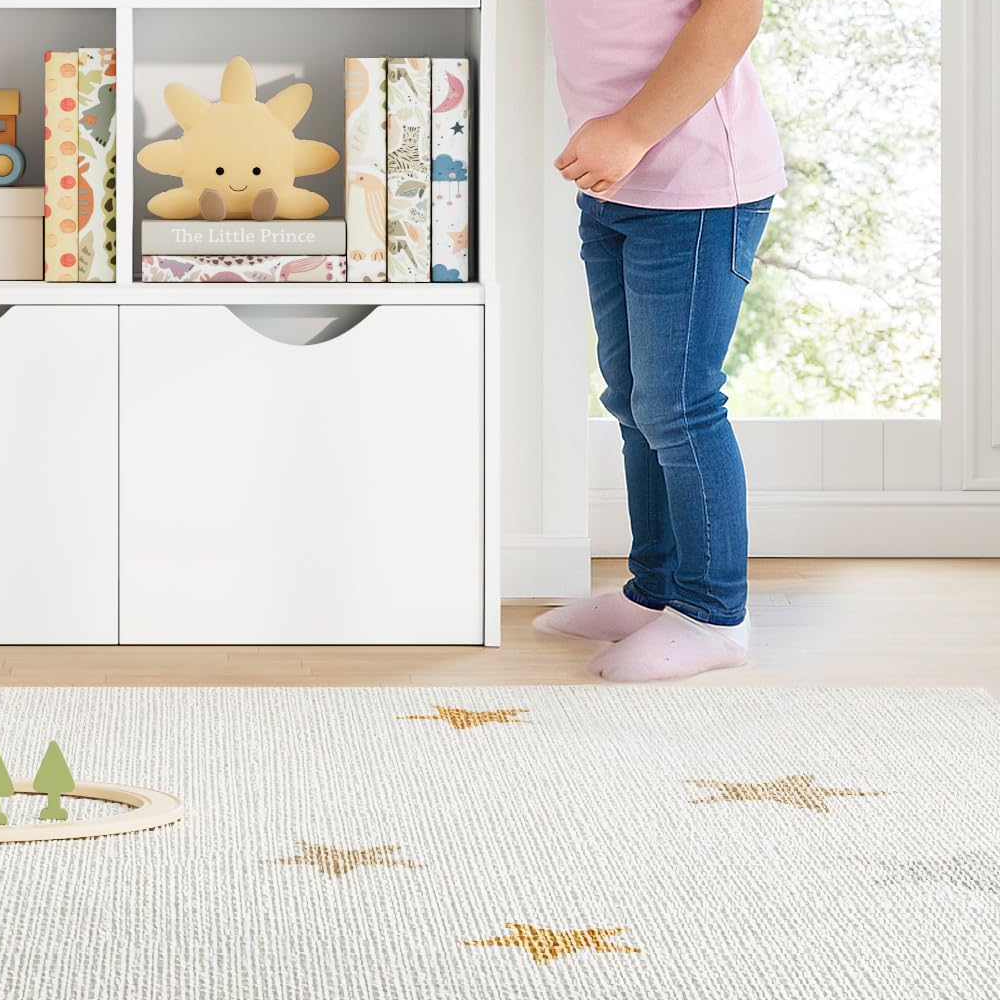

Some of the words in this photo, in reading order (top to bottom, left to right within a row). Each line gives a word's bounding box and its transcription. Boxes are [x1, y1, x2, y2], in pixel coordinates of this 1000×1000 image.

[171, 228, 203, 243] The
[208, 228, 255, 243] Little
[260, 228, 316, 243] Prince
